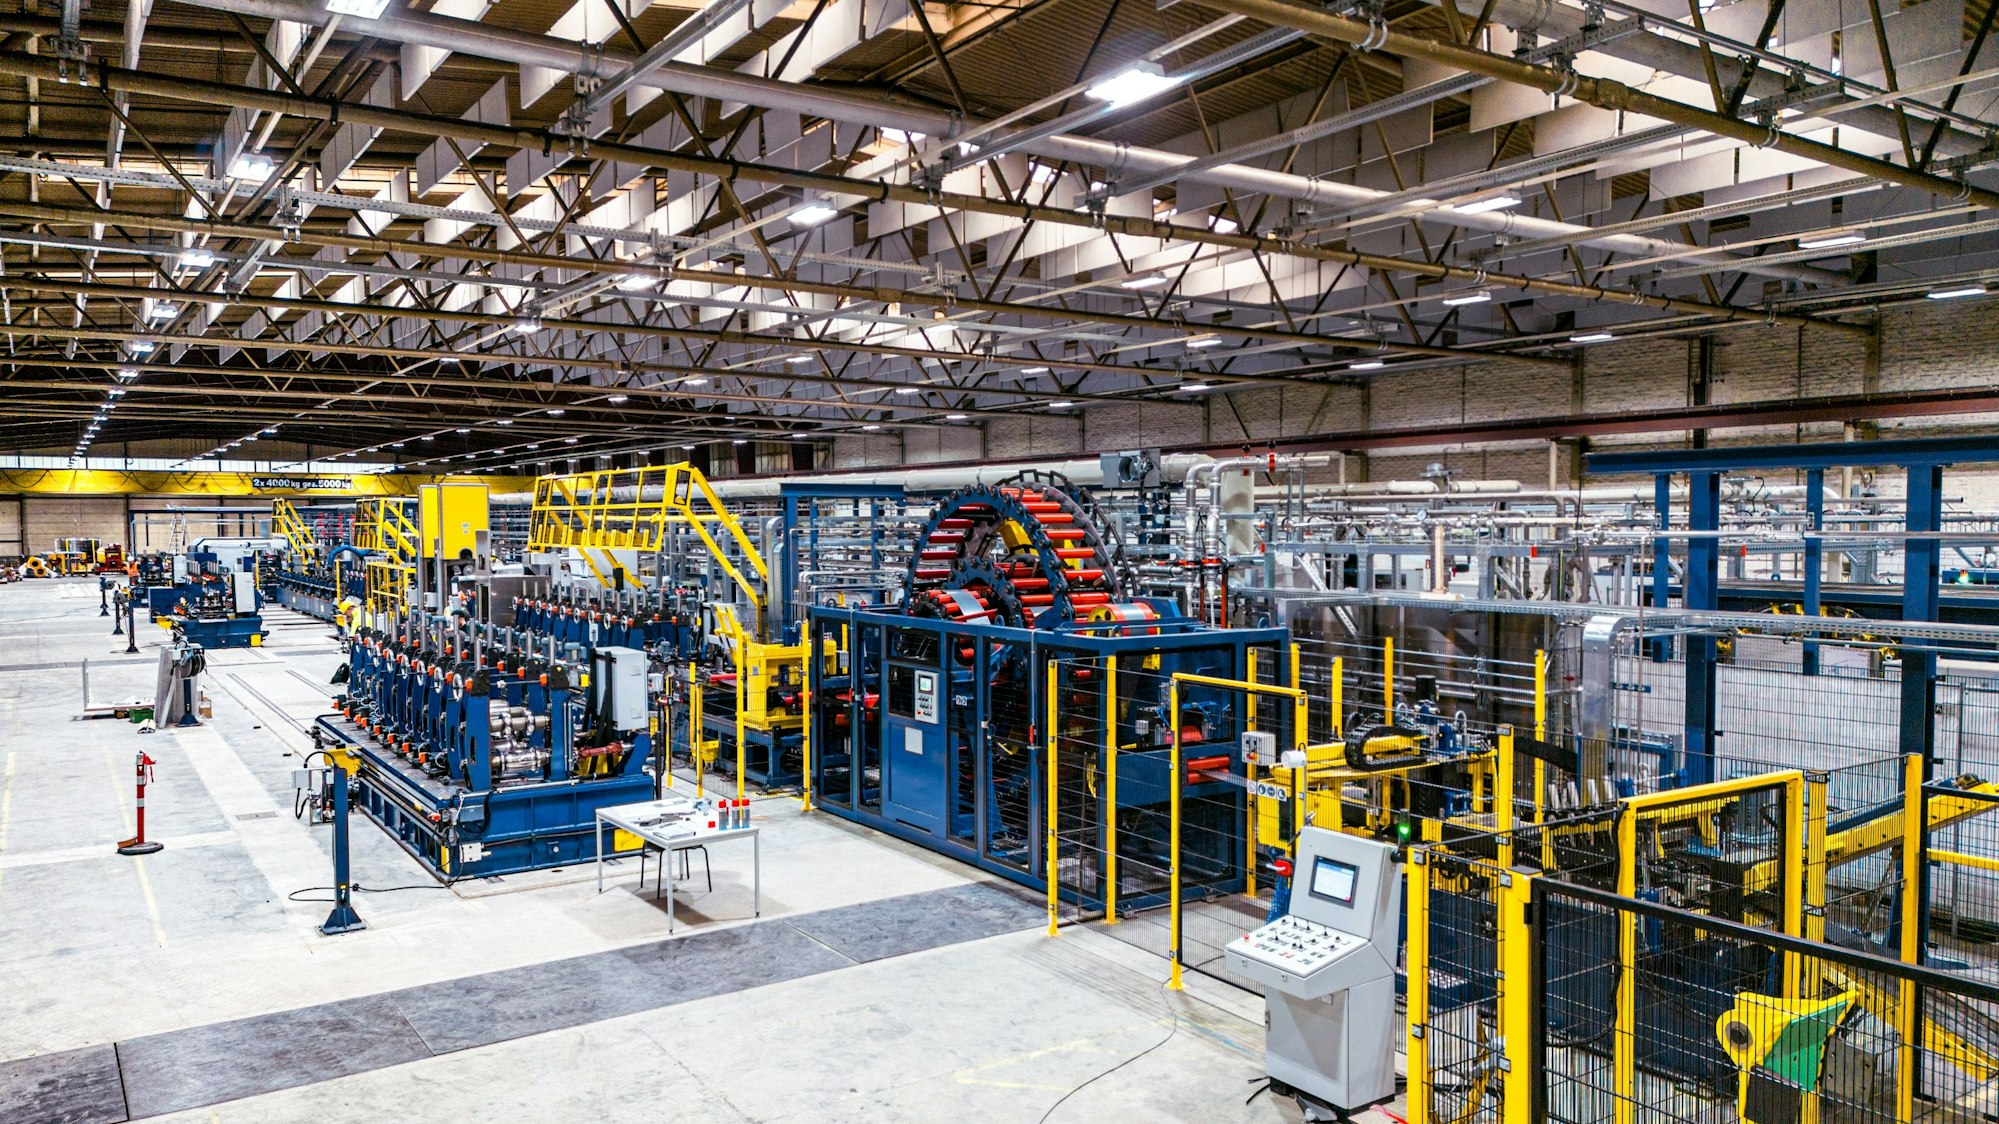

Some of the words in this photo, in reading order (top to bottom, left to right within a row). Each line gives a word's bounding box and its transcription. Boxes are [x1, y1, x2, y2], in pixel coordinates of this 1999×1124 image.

[266, 478, 290, 487] 4000
[291, 480, 300, 488] kg
[318, 479, 341, 488] 5000
[341, 480, 351, 489] kg
